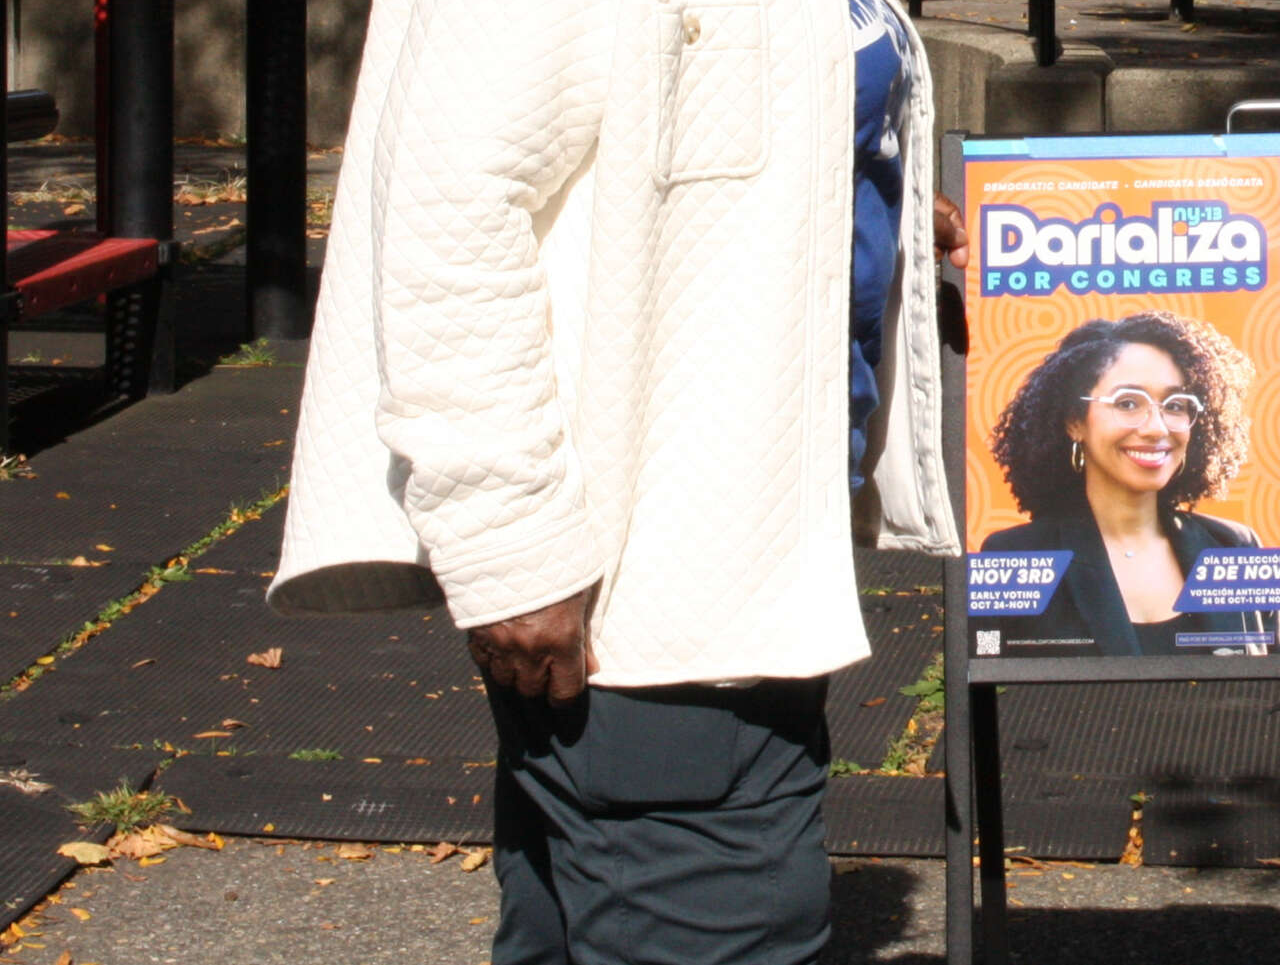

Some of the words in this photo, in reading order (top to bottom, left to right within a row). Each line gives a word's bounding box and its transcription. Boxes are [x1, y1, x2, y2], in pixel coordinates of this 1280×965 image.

[984, 182, 1053, 191] DEMOCRATIC
[1058, 181, 1118, 190] CANDIDATE
[1134, 179, 1194, 188] CANDIDATA
[1174, 207, 1222, 226] ny-13
[987, 208, 1260, 267] Darializa
[988, 271, 1050, 290] FOR
[1071, 267, 1260, 288] CONGRESS
[971, 558, 1027, 568] ELECTION
[1031, 558, 1054, 568] DAY
[1204, 555, 1220, 565] DÍA
[1222, 556, 1235, 564] DE
[970, 570, 1013, 584] NOV
[1017, 570, 1055, 584] 3RD
[1196, 567, 1207, 581] 3
[1213, 566, 1239, 580] DE
[971, 592, 1000, 600] EARLY
[1003, 591, 1040, 599] VOTING
[1190, 588, 1233, 596] VOTACIÓN
[971, 601, 990, 609] OCT
[1255, 596, 1268, 604] DE
